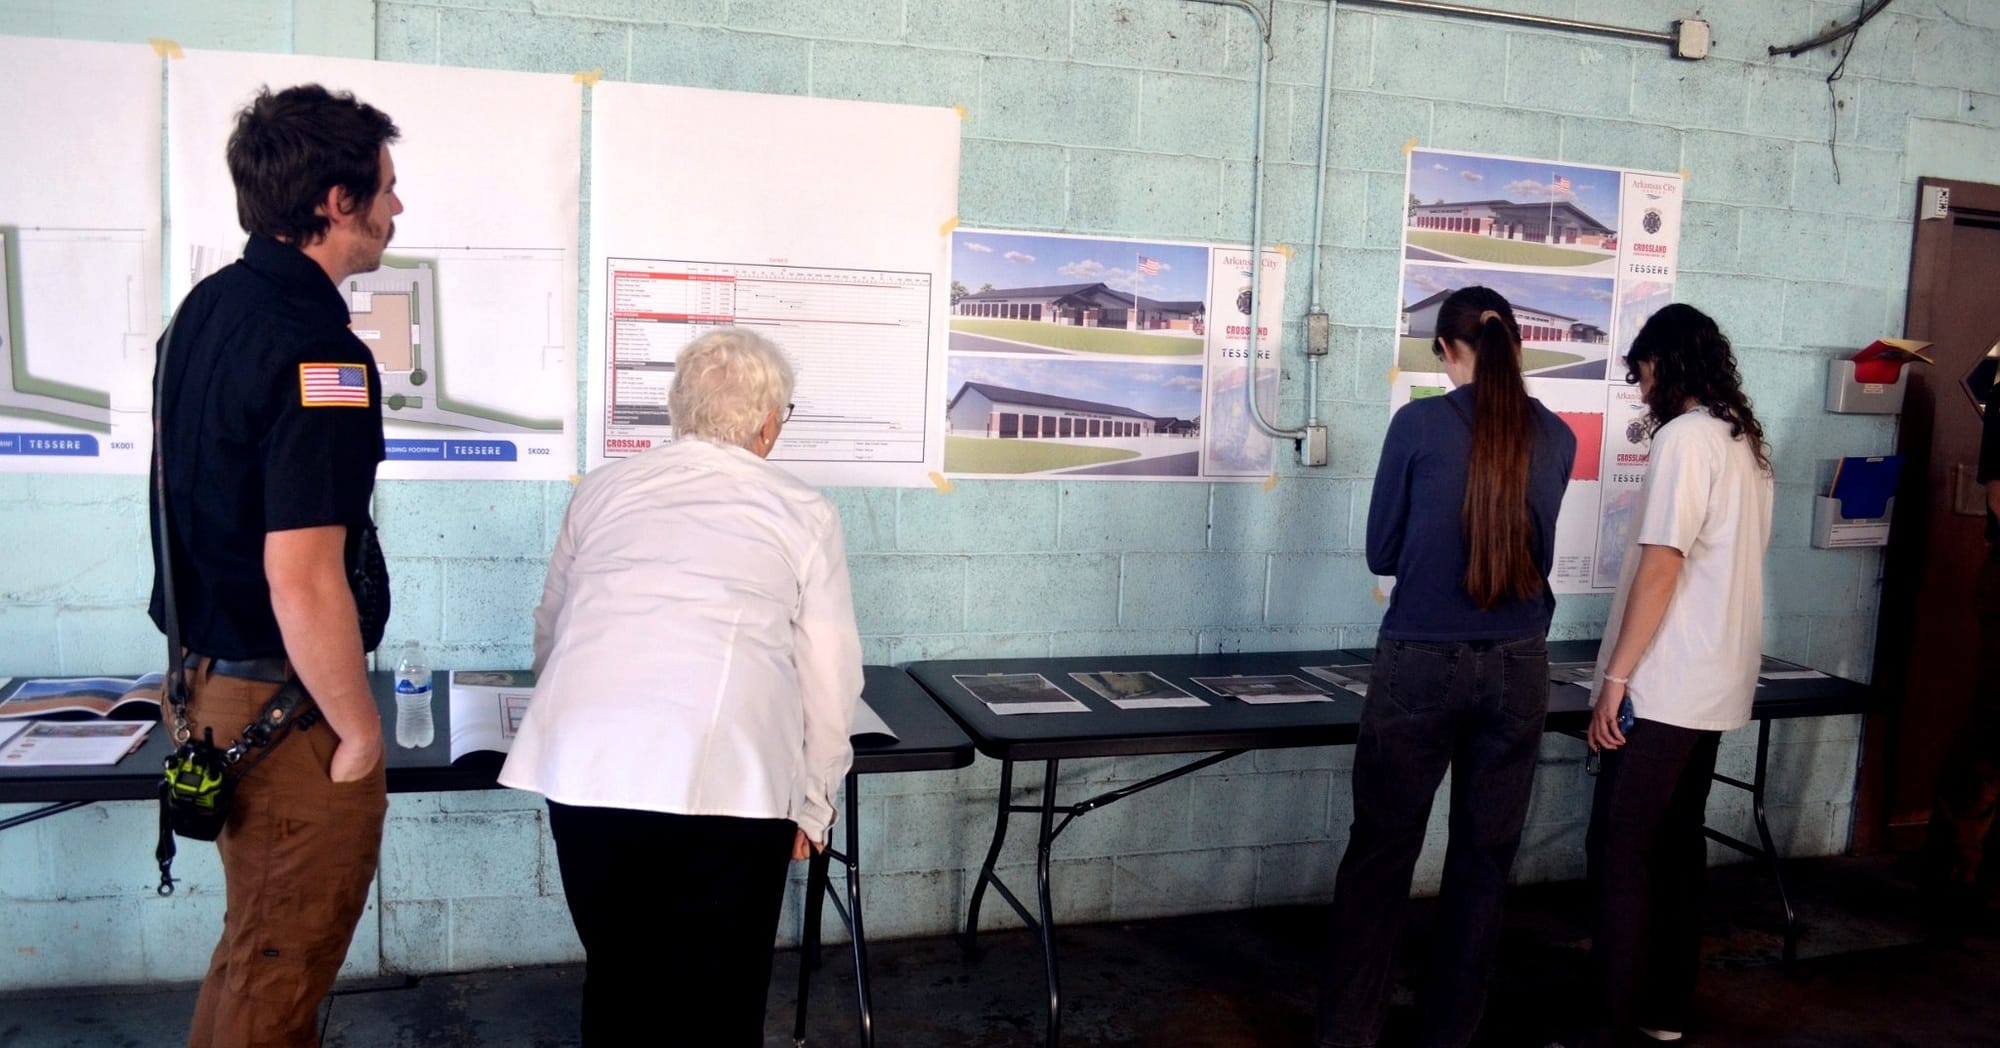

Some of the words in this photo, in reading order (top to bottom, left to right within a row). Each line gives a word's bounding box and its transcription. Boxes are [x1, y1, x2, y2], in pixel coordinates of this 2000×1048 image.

[1663, 184, 1675, 193] City
[1633, 243, 1667, 253] CROSSLAND
[1262, 258, 1278, 270] City
[1629, 264, 1669, 275] TESSERE
[1226, 325, 1268, 336] CROSSND
[1221, 348, 1271, 359] TESSRE
[29, 440, 81, 449] TESSERE
[606, 439, 651, 448] CROSSLAND
[454, 446, 501, 455] TESSERE
